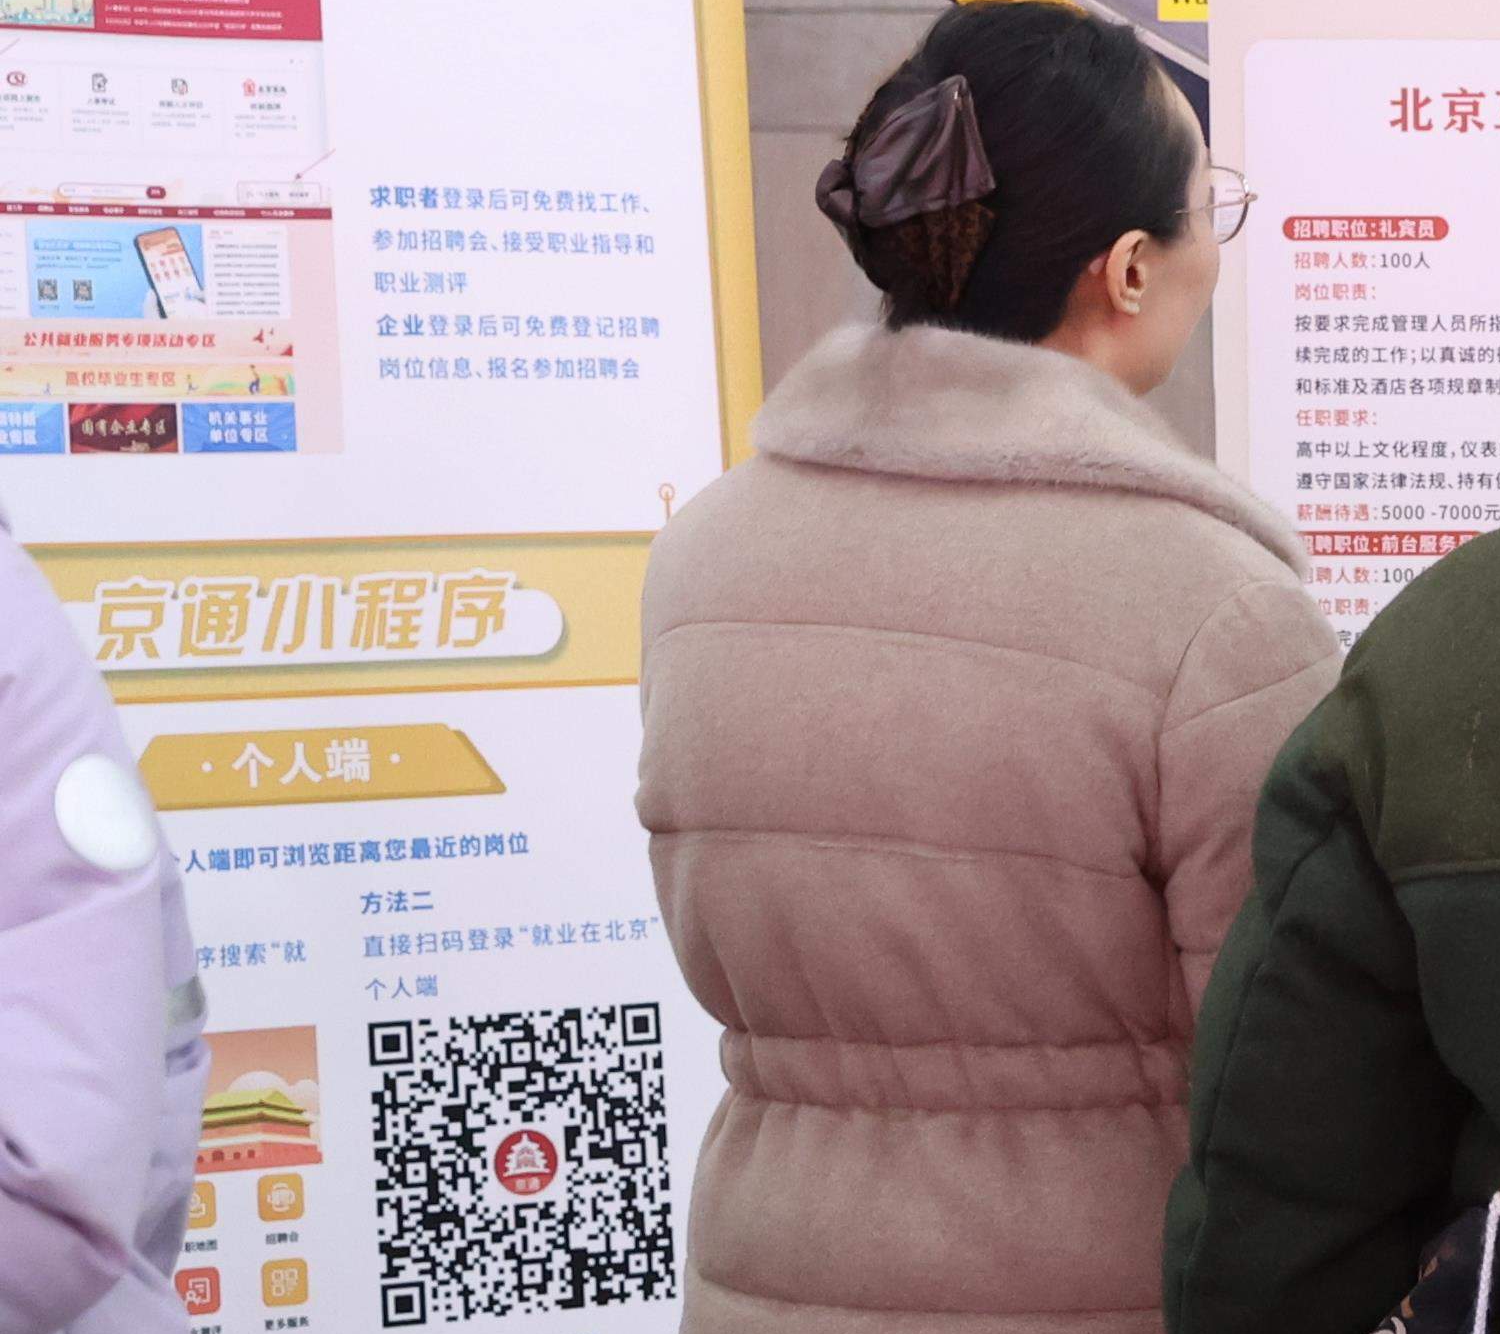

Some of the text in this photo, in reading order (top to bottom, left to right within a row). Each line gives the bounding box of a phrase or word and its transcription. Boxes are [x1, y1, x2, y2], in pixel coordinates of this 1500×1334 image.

[370, 184, 651, 216] 求职者登录后可免费找工作、
[372, 228, 655, 256] 参加招聘会、接受职业指导和
[1293, 220, 1435, 240] 招聘职位：礼宾员
[1294, 252, 1430, 270] 招聘人数：100人
[374, 270, 468, 295] 职业测评
[1295, 284, 1377, 301] 岗位职责：
[376, 313, 660, 340] 企业登录后可免费登记招聘
[379, 355, 641, 381] 岗位信息、报名参加招聘会
[1296, 409, 1378, 427] 任职要求：
[95, 571, 510, 661] 京通小程序
[231, 736, 373, 788] 个人端
[171, 832, 530, 873] 人端即可浏览距离您最近的岗位
[361, 890, 435, 915] 方法二
[365, 975, 439, 1001] 个人端
